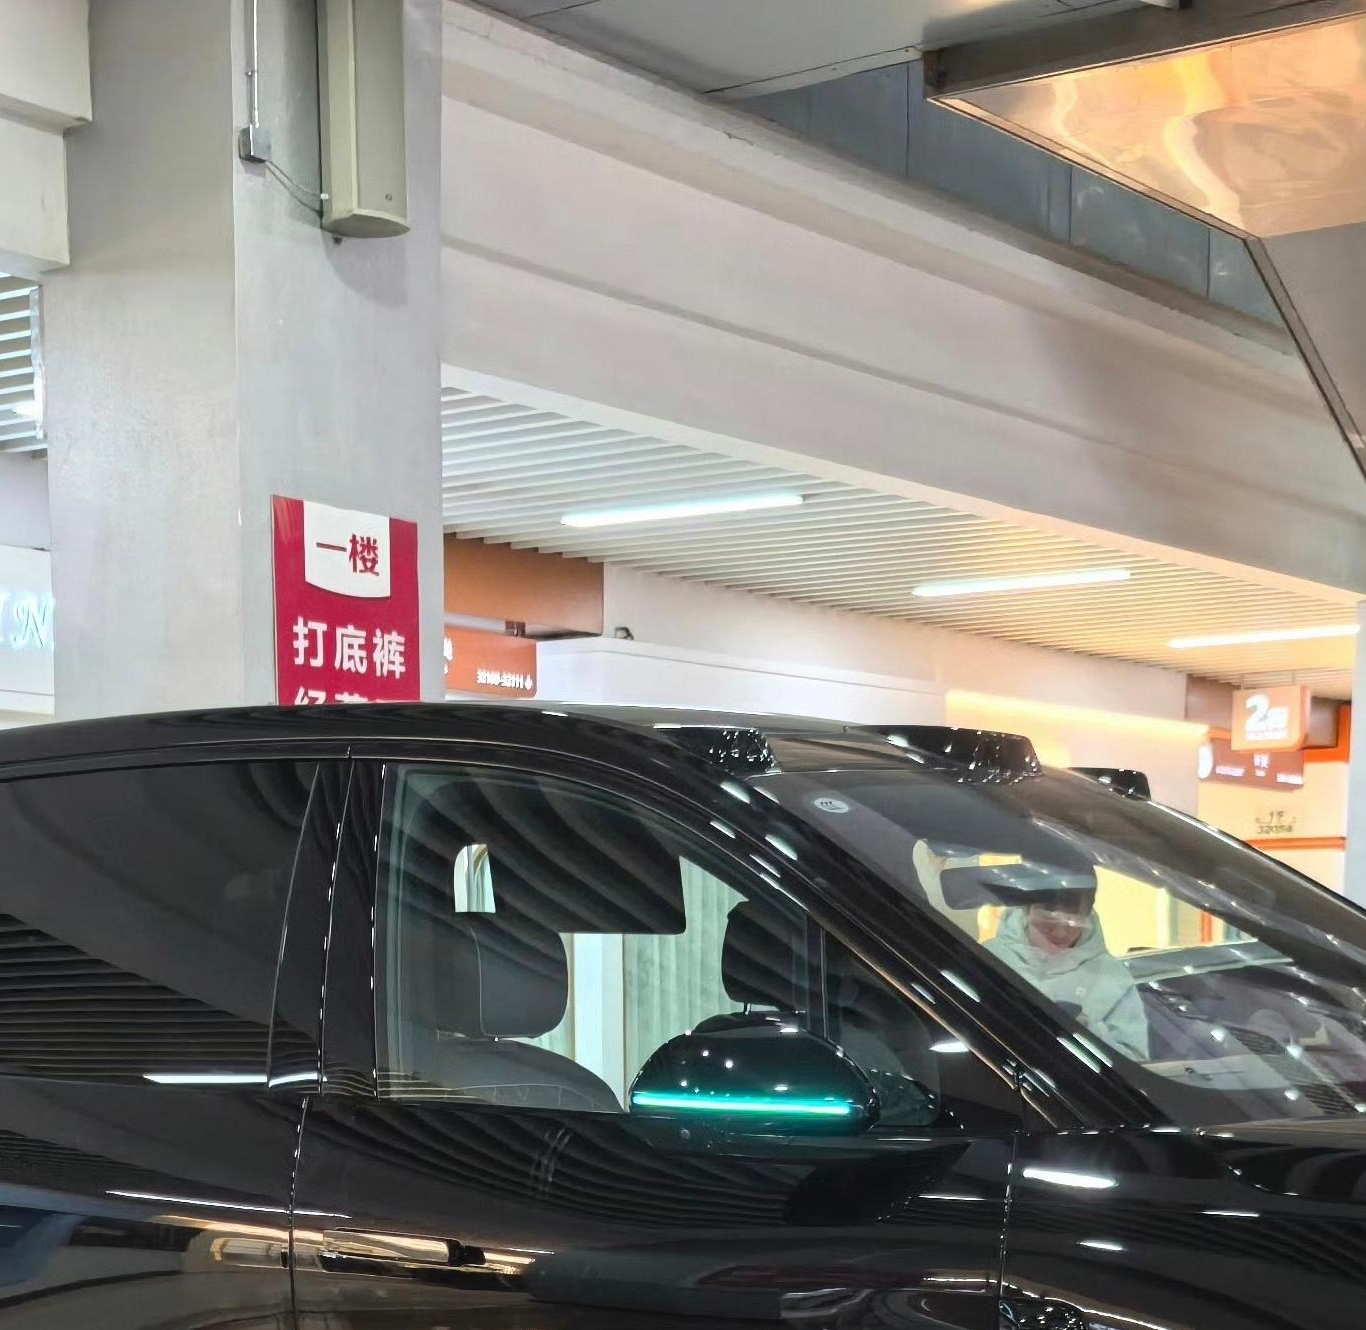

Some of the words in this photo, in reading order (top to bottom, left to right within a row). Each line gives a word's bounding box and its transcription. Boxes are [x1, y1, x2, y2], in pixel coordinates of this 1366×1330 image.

[315, 533, 380, 576] 一楼
[292, 615, 406, 680] 打底裤
